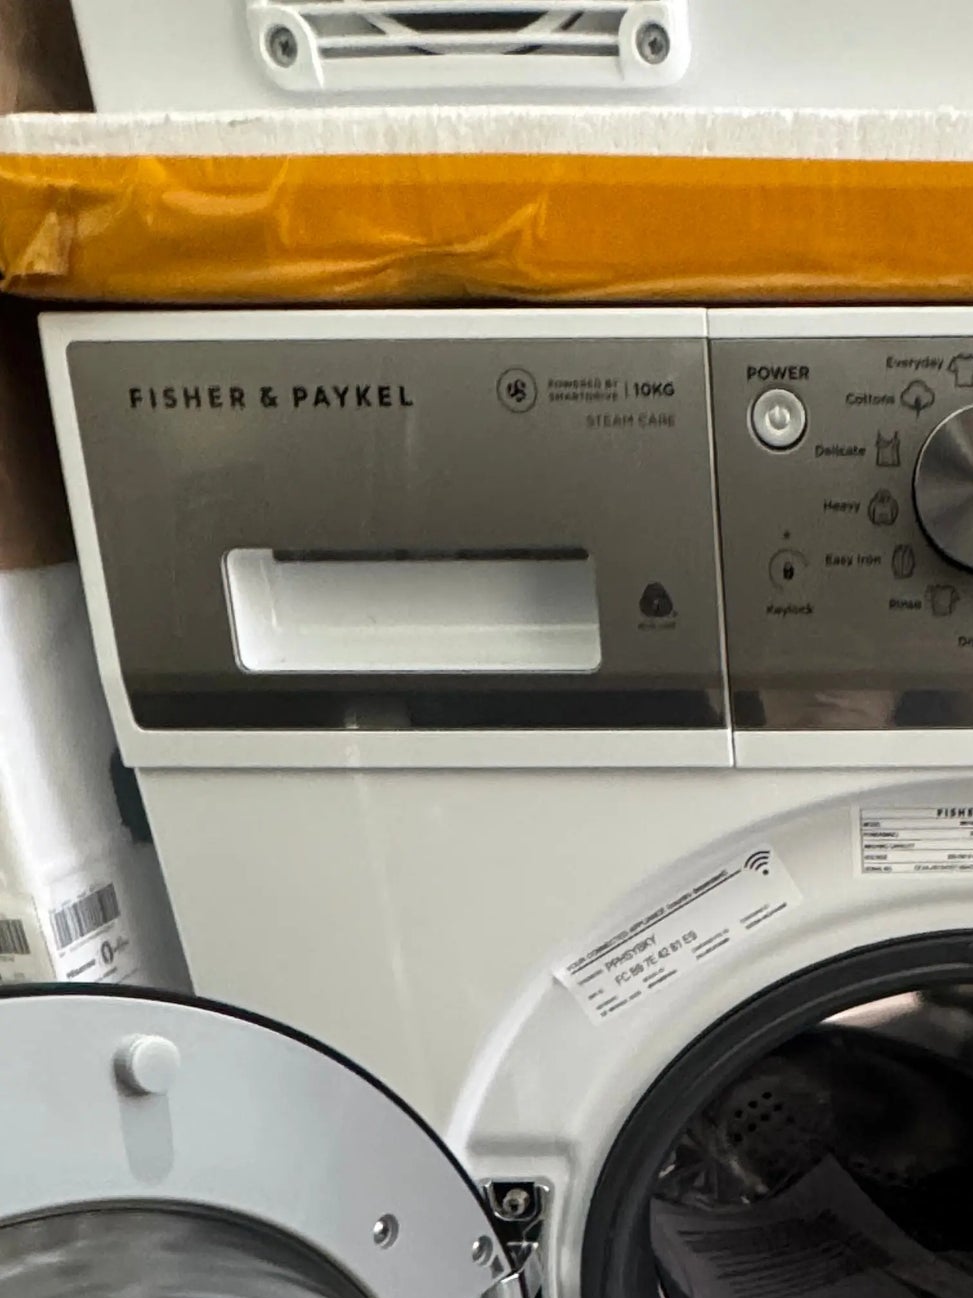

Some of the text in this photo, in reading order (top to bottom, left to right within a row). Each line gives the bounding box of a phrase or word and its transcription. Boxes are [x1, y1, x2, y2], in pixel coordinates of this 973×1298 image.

[886, 355, 944, 371] Everyday
[747, 365, 810, 380] POWER
[634, 381, 676, 397] 10KG
[129, 385, 415, 410] FISHER & PAYKEL
[586, 414, 634, 427] STEAM
[814, 443, 866, 458] Delicate
[823, 499, 861, 514] Heavy
[825, 553, 882, 568] Easy Iron
[766, 604, 814, 618] Keylock
[889, 598, 922, 611] Rinse
